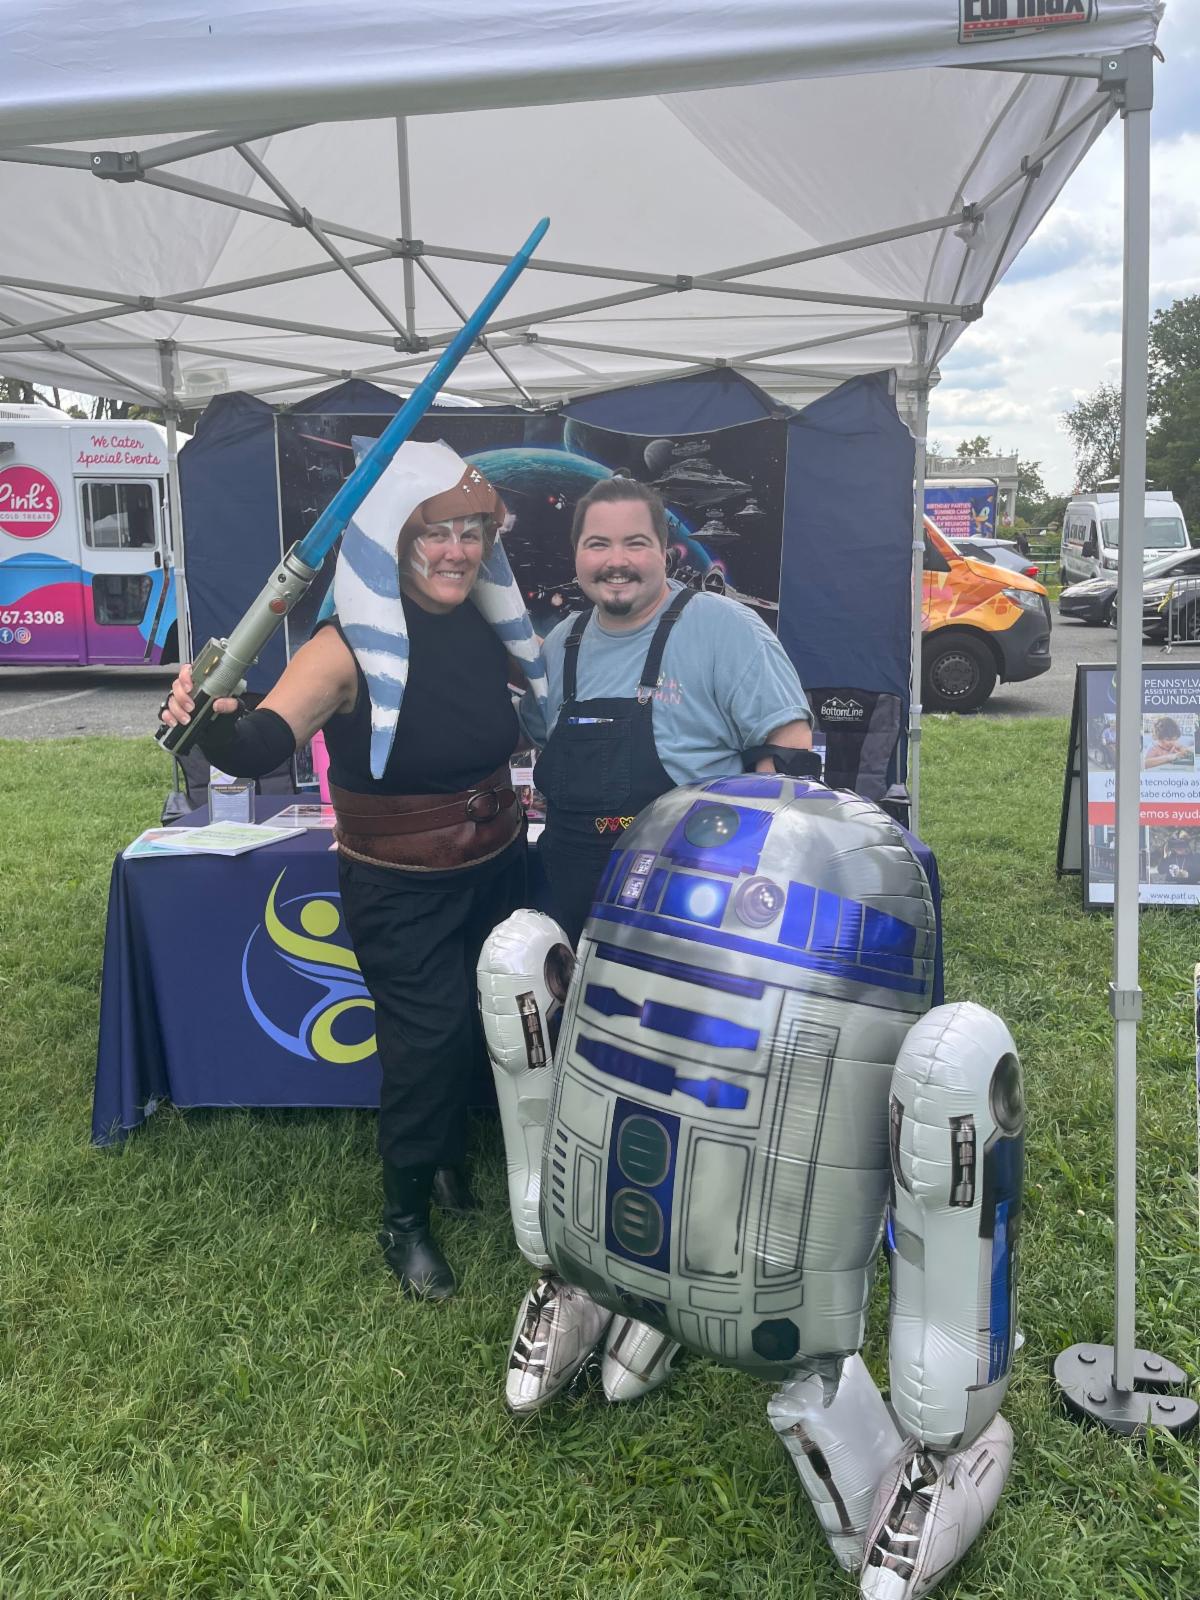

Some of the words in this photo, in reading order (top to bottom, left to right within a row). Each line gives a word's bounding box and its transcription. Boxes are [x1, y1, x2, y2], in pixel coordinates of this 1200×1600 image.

[91, 435, 109, 447] We
[111, 435, 144, 449] Cater
[76, 451, 123, 468] Special
[124, 452, 161, 465] Events
[0, 610, 65, 625] 67.3308
[1144, 678, 1200, 688] PENNSYLV
[1145, 777, 1189, 788] tecnología
[1140, 790, 1160, 798] sabe
[1161, 789, 1185, 798] cómo
[1139, 810, 1169, 819] emos
